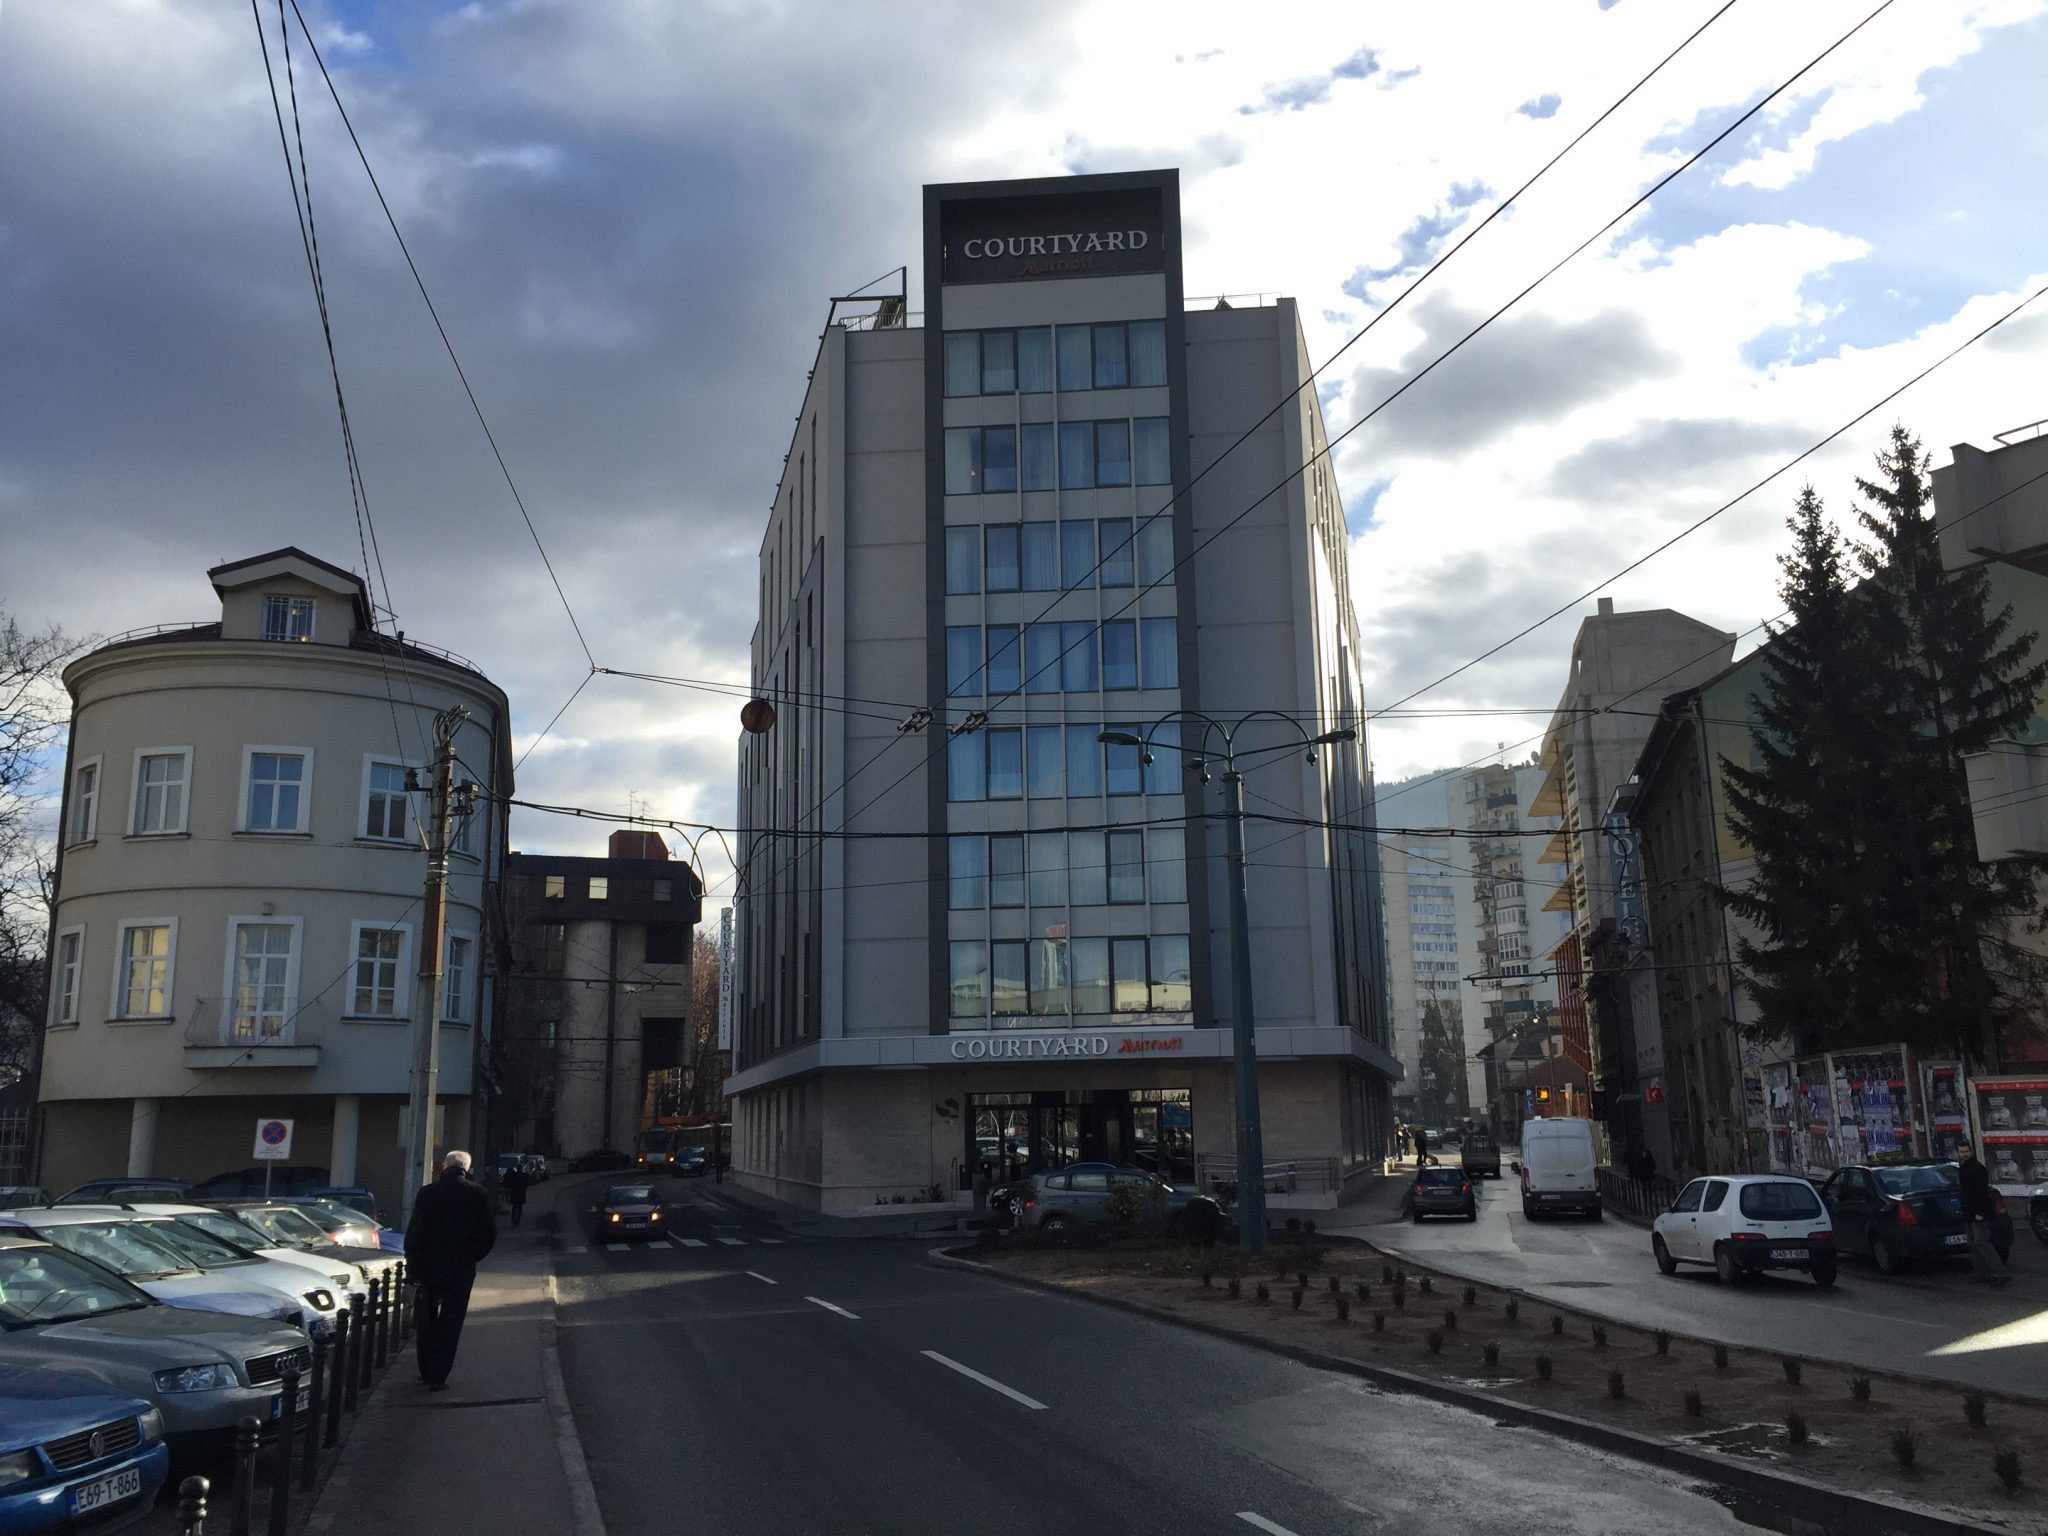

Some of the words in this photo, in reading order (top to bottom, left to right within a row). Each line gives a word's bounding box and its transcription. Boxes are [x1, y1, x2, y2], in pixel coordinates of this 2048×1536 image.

[964, 230, 1148, 259] COURTYARD
[1611, 816, 1637, 920] HOTEL
[722, 915, 731, 993] COURTYARD
[951, 1036, 1109, 1058] COURTYARD
[77, 1471, 139, 1509] E69-T-866
